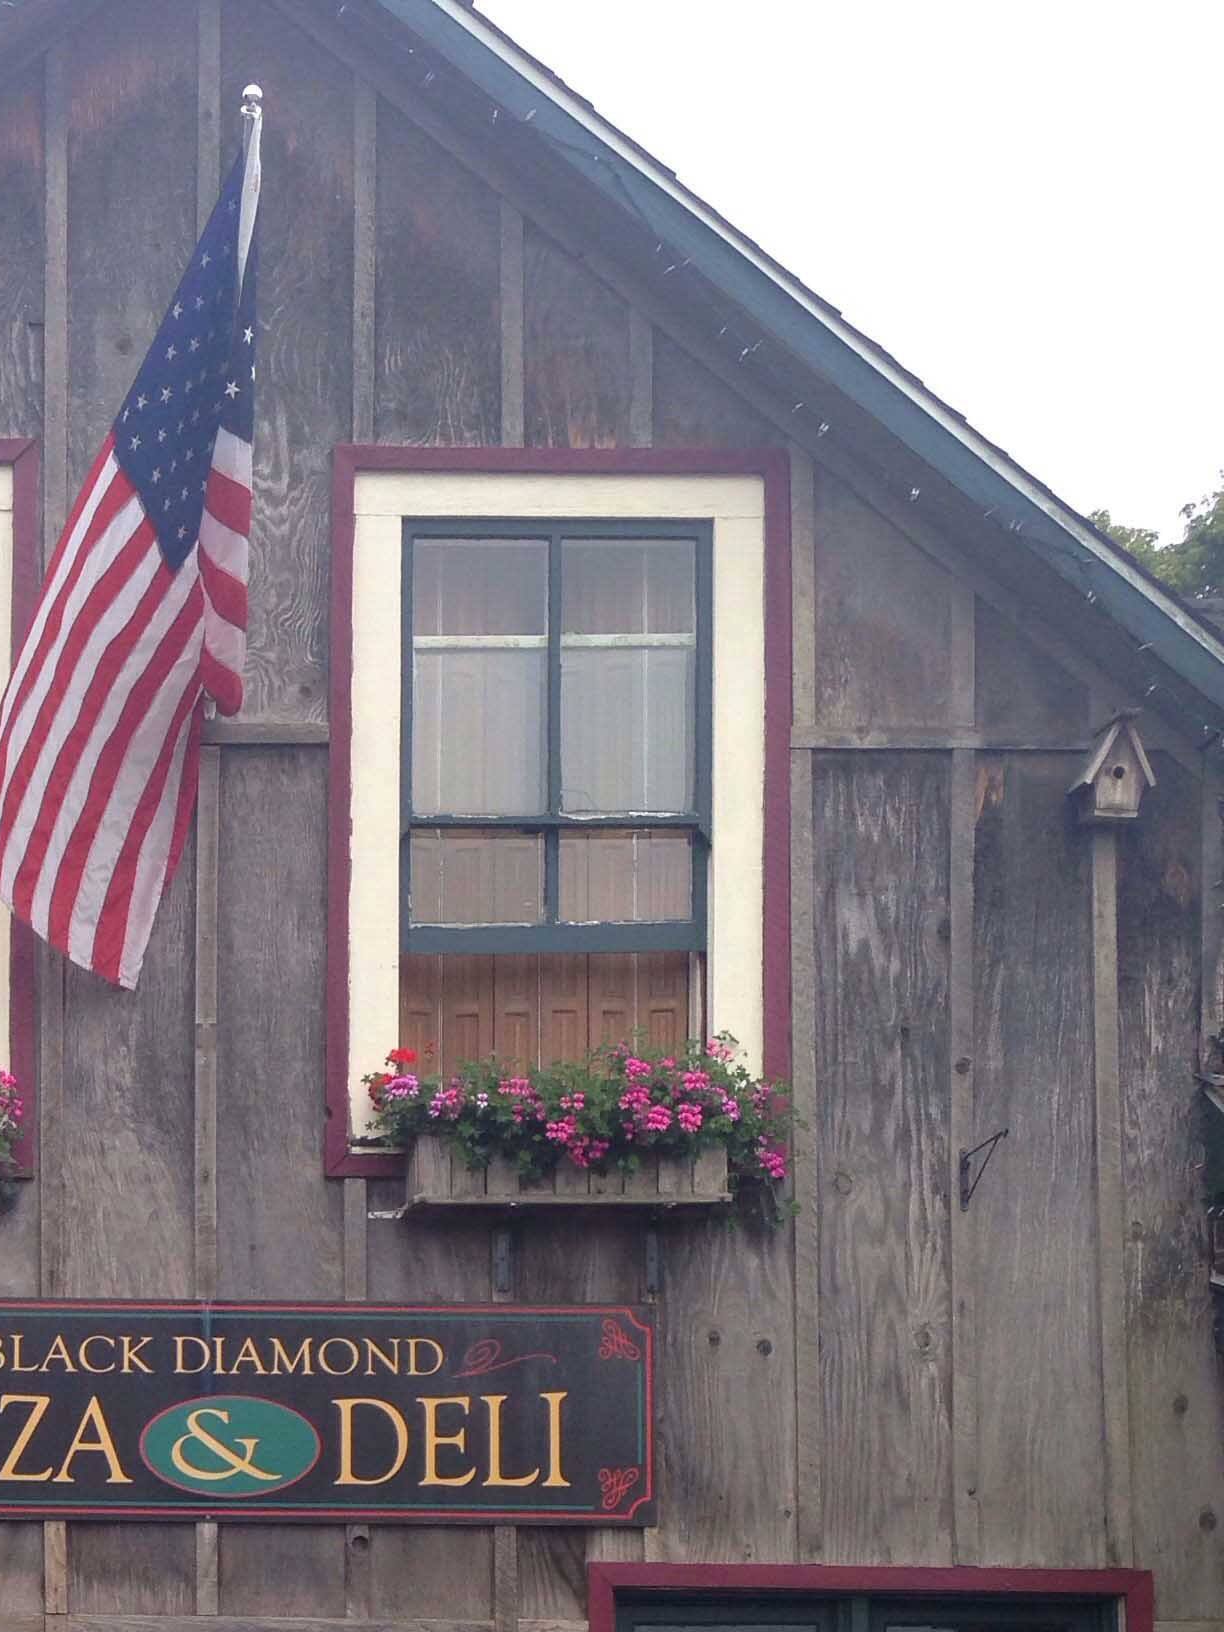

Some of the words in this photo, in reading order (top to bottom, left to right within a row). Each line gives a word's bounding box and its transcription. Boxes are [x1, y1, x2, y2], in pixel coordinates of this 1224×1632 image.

[174, 1337, 444, 1377] DIAMOND
[170, 1409, 283, 1480] &
[333, 1391, 573, 1488] DELI
